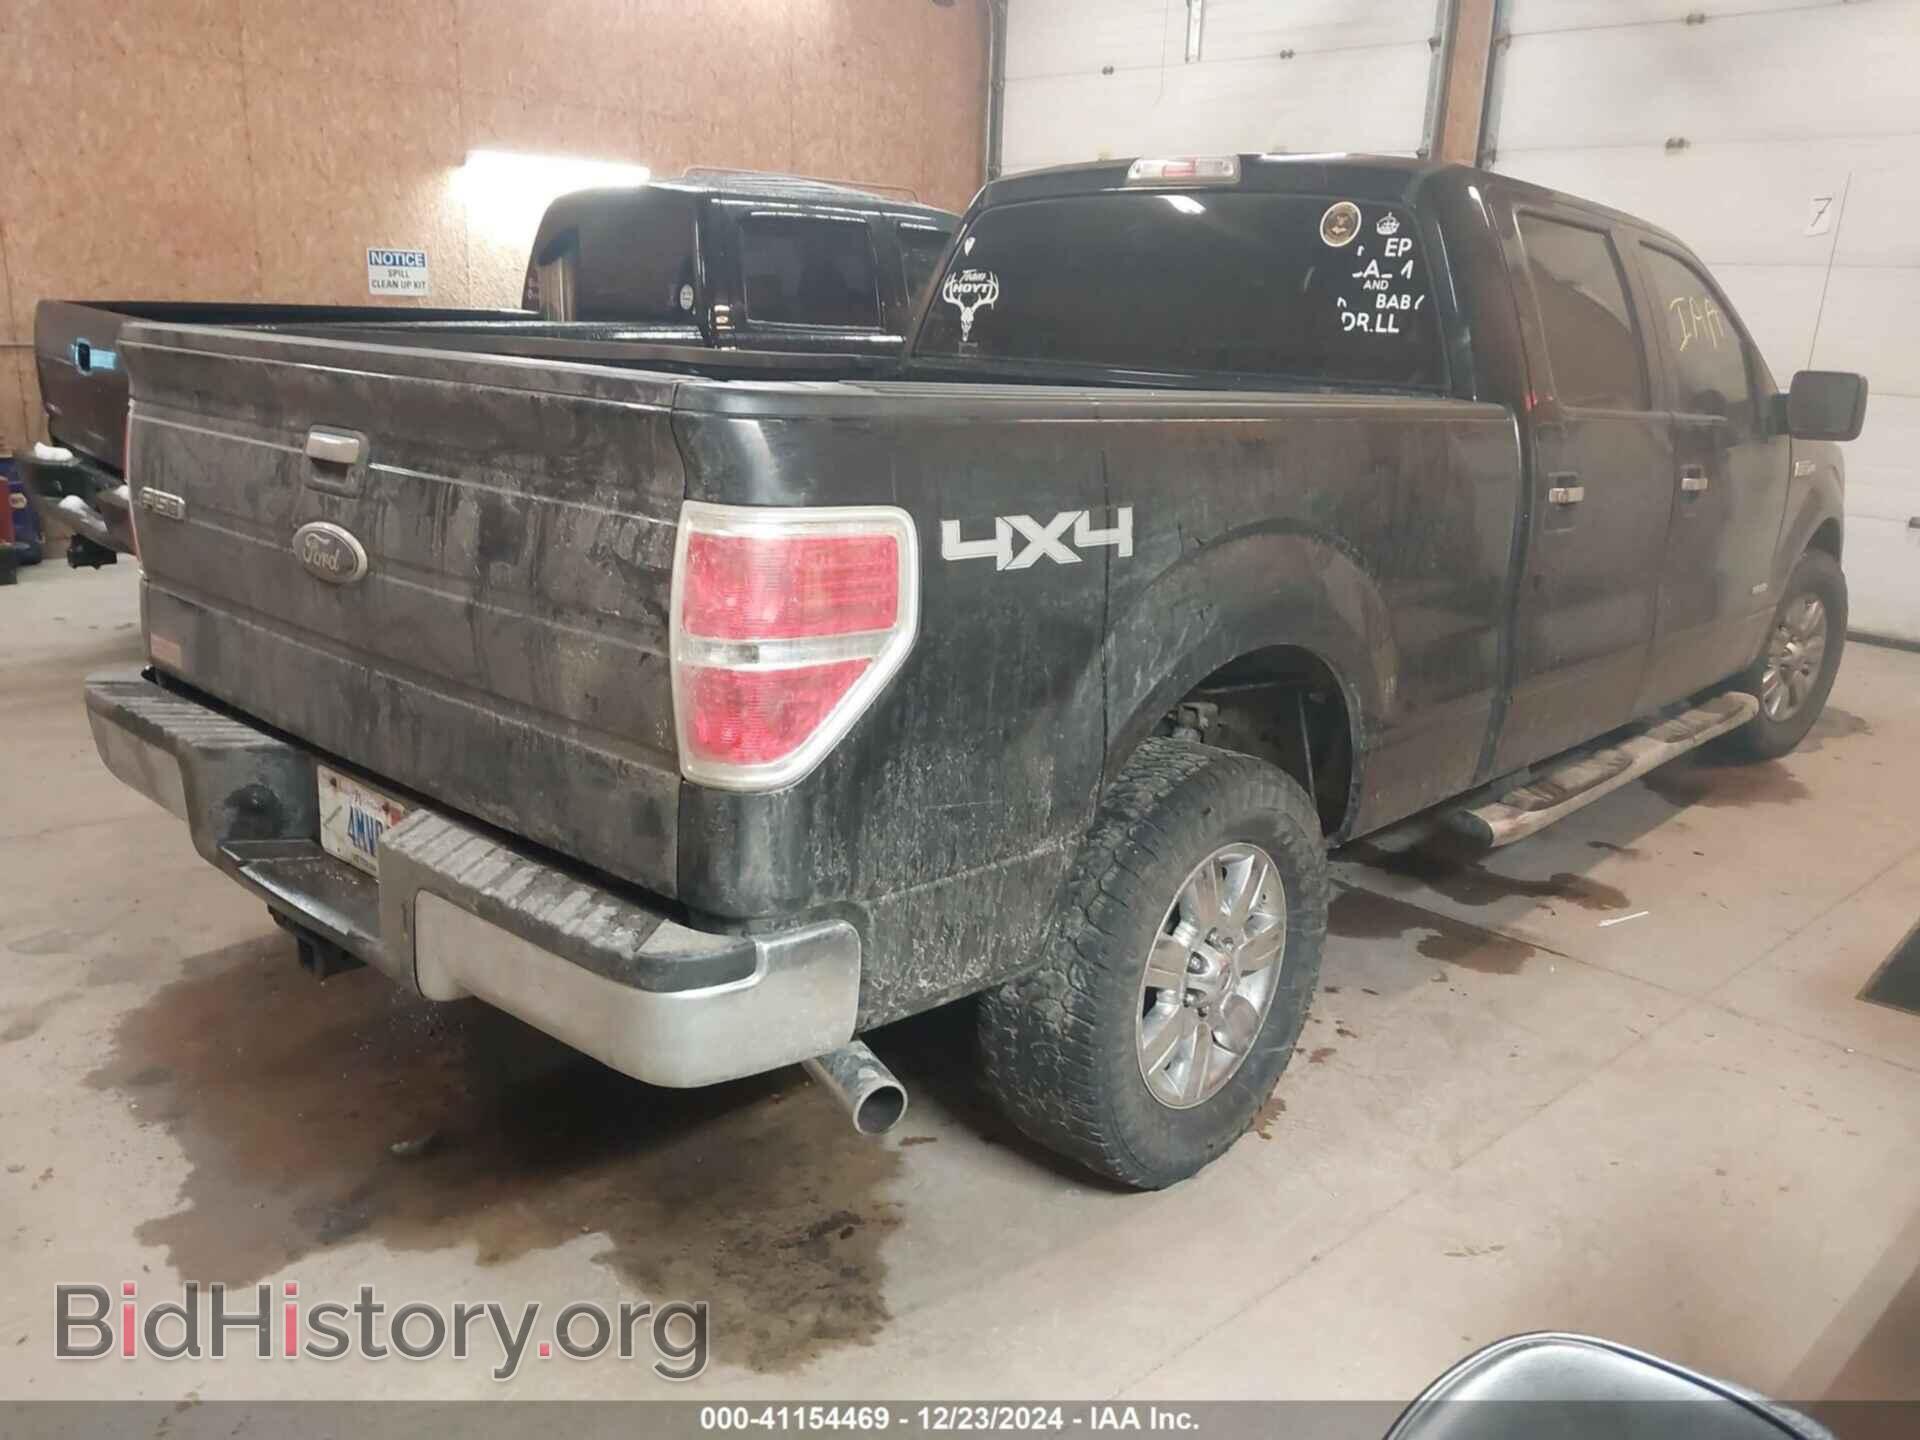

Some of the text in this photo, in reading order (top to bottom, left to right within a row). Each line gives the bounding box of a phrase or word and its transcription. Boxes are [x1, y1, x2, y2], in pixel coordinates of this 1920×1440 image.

[370, 251, 424, 266] NOTICE
[387, 269, 409, 278] SPILL
[371, 280, 399, 288] CLEAN
[414, 281, 425, 289] KIT
[1363, 279, 1389, 290] AND
[304, 532, 340, 571] Ford
